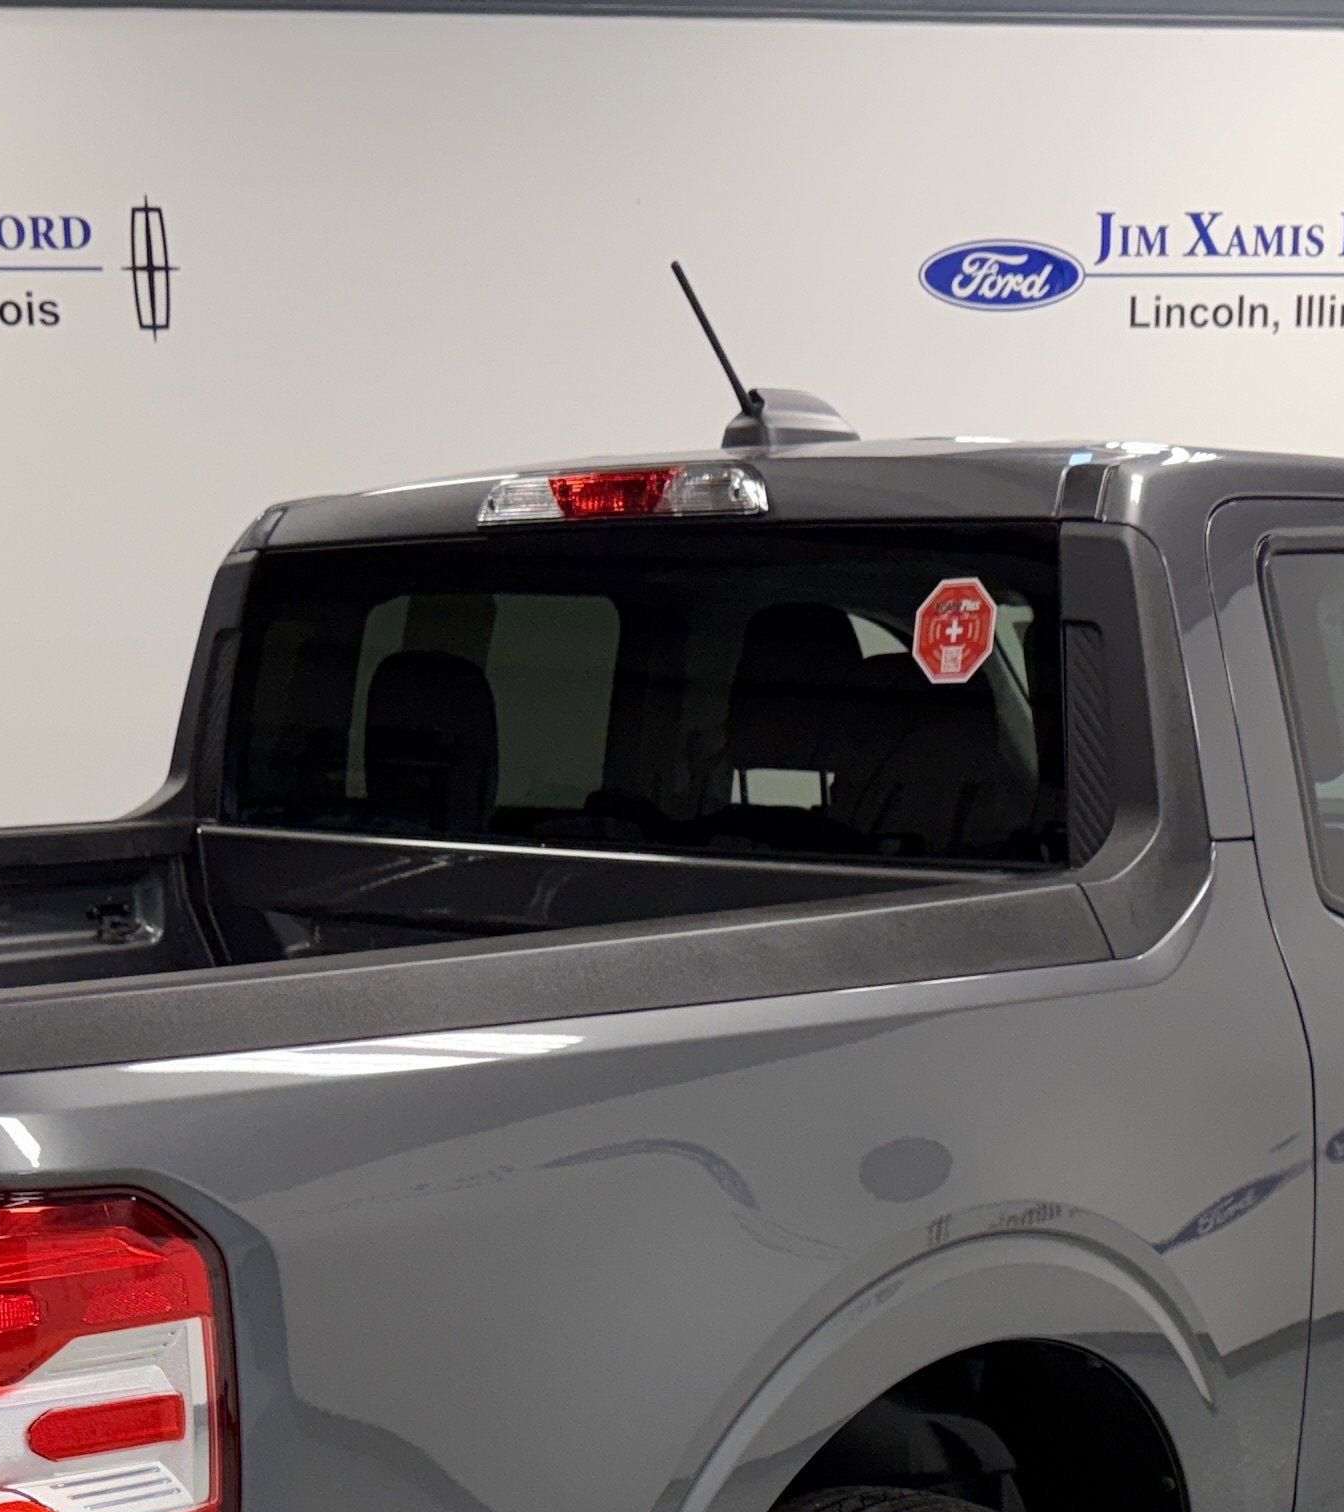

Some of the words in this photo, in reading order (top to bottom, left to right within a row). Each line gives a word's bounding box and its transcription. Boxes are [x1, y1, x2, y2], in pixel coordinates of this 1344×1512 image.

[1094, 212, 1170, 266] JIM
[1184, 212, 1325, 259] XAMIS
[951, 250, 1053, 300] Ford
[1129, 296, 1281, 336] Lincoln,
